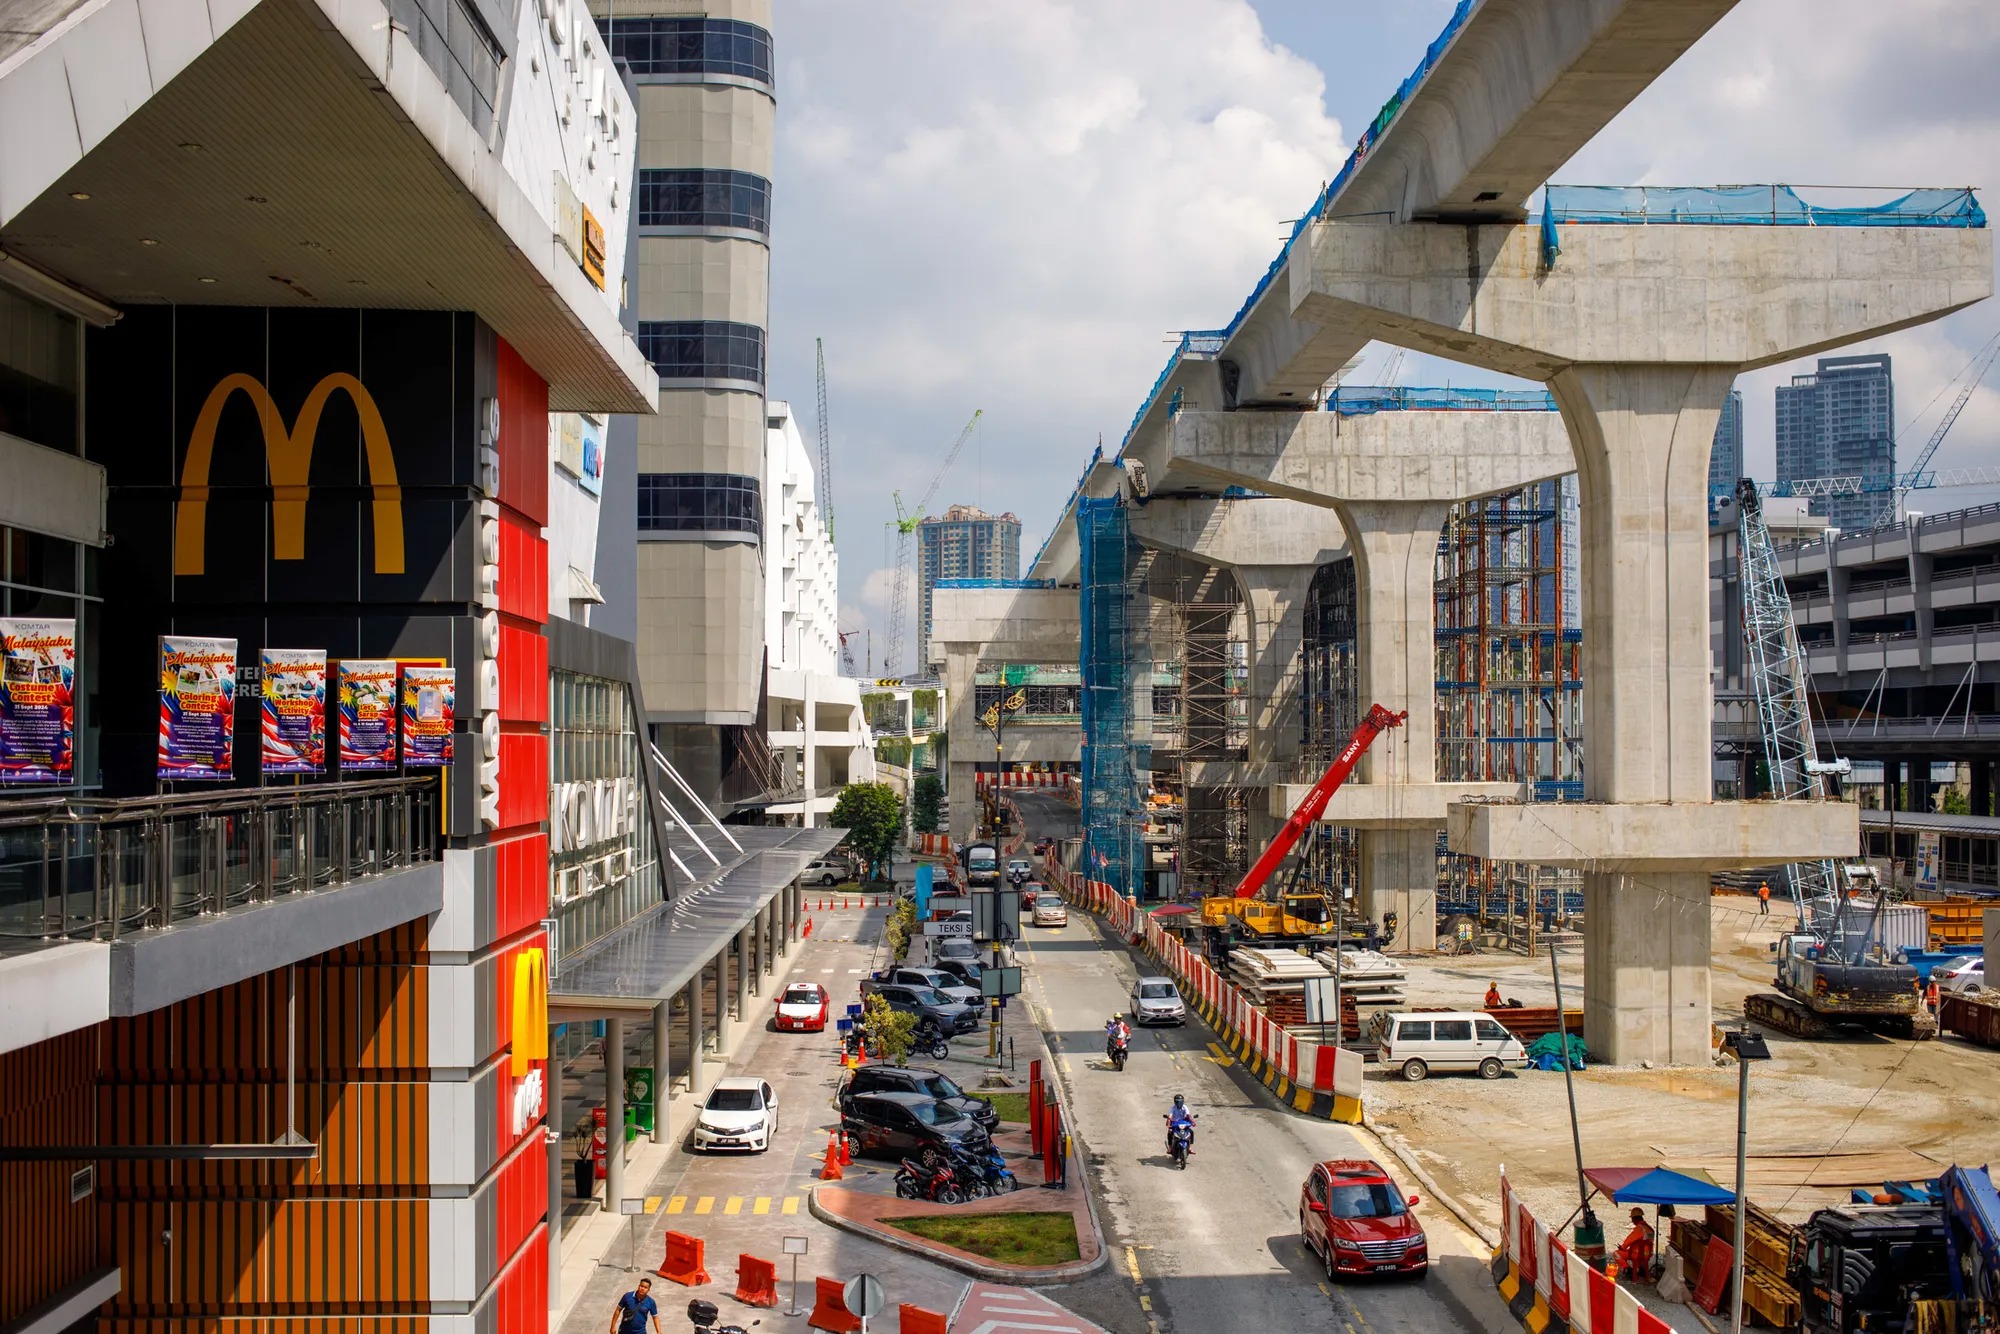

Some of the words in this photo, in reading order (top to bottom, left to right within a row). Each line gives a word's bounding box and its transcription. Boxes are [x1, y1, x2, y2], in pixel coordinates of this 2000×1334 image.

[0, 635, 73, 652] Malaysiaku
[166, 652, 234, 667] Malaysiaku
[266, 662, 325, 675] Malaysiaku
[343, 671, 395, 683] Malaysiaku
[9, 682, 55, 692] Costume
[407, 677, 454, 688] Malaysiaku
[11, 693, 52, 703] Contest
[179, 692, 216, 702] Coloring
[181, 702, 216, 711] Contest
[274, 699, 313, 707] Workshop
[278, 707, 309, 715] Activity
[1342, 739, 1360, 763] SANY
[938, 924, 963, 933] TEKSI
